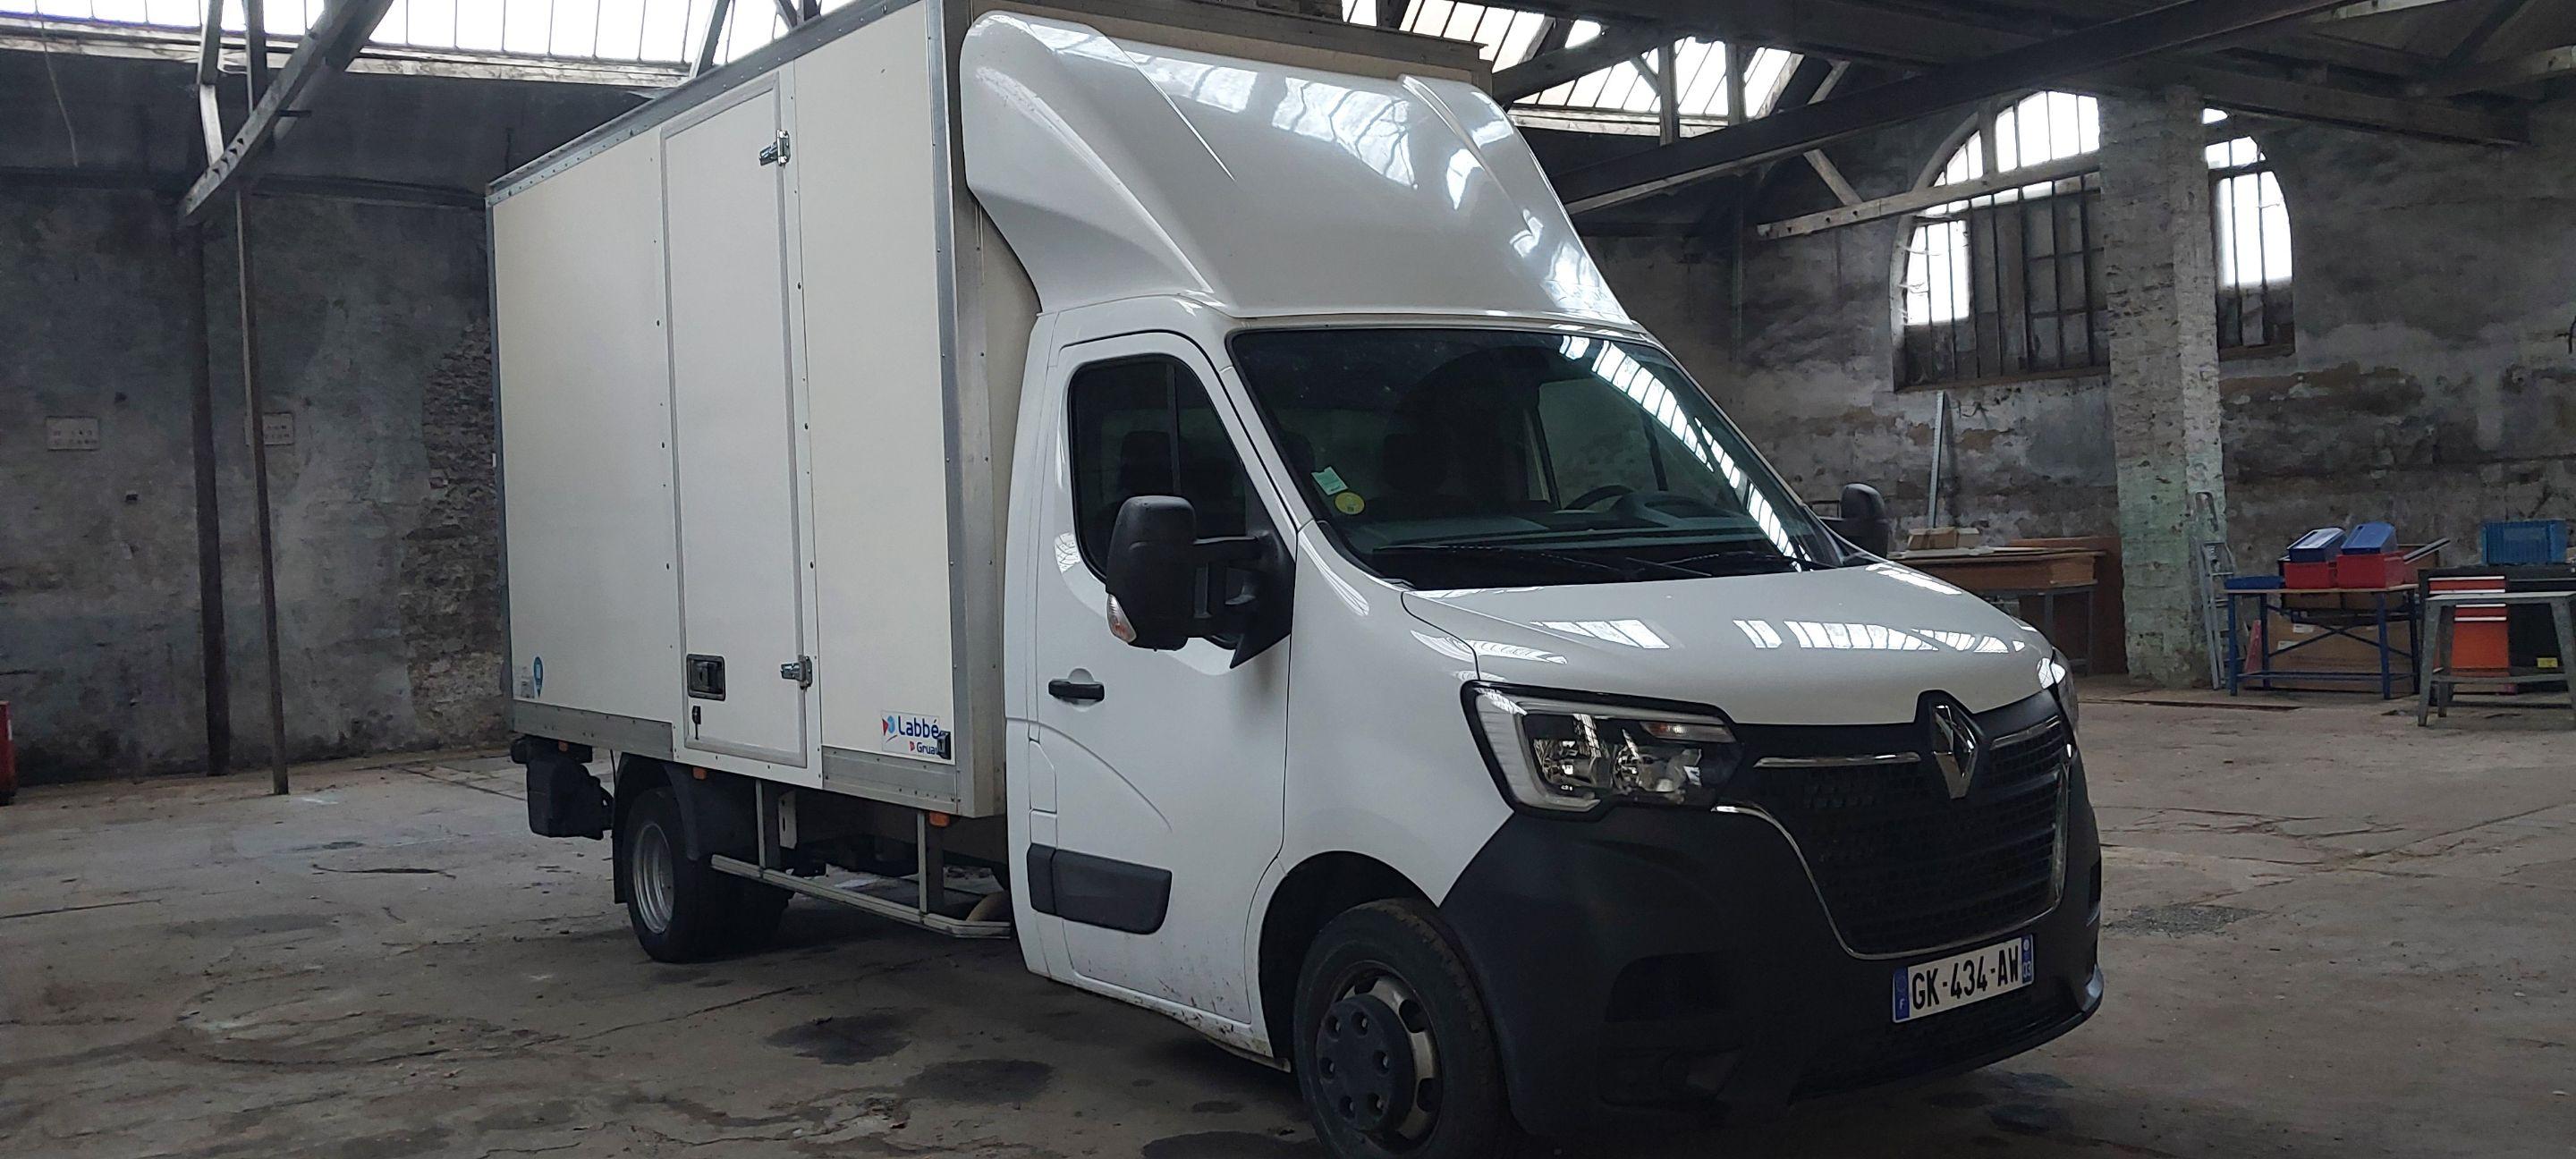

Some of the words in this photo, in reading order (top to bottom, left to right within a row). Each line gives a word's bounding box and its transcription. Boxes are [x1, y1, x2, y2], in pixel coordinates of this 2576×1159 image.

[898, 715, 939, 739] Labbé
[917, 742, 938, 755] Grua
[1912, 945, 2019, 1010] GK-434-AW
[1899, 998, 1905, 1010] F
